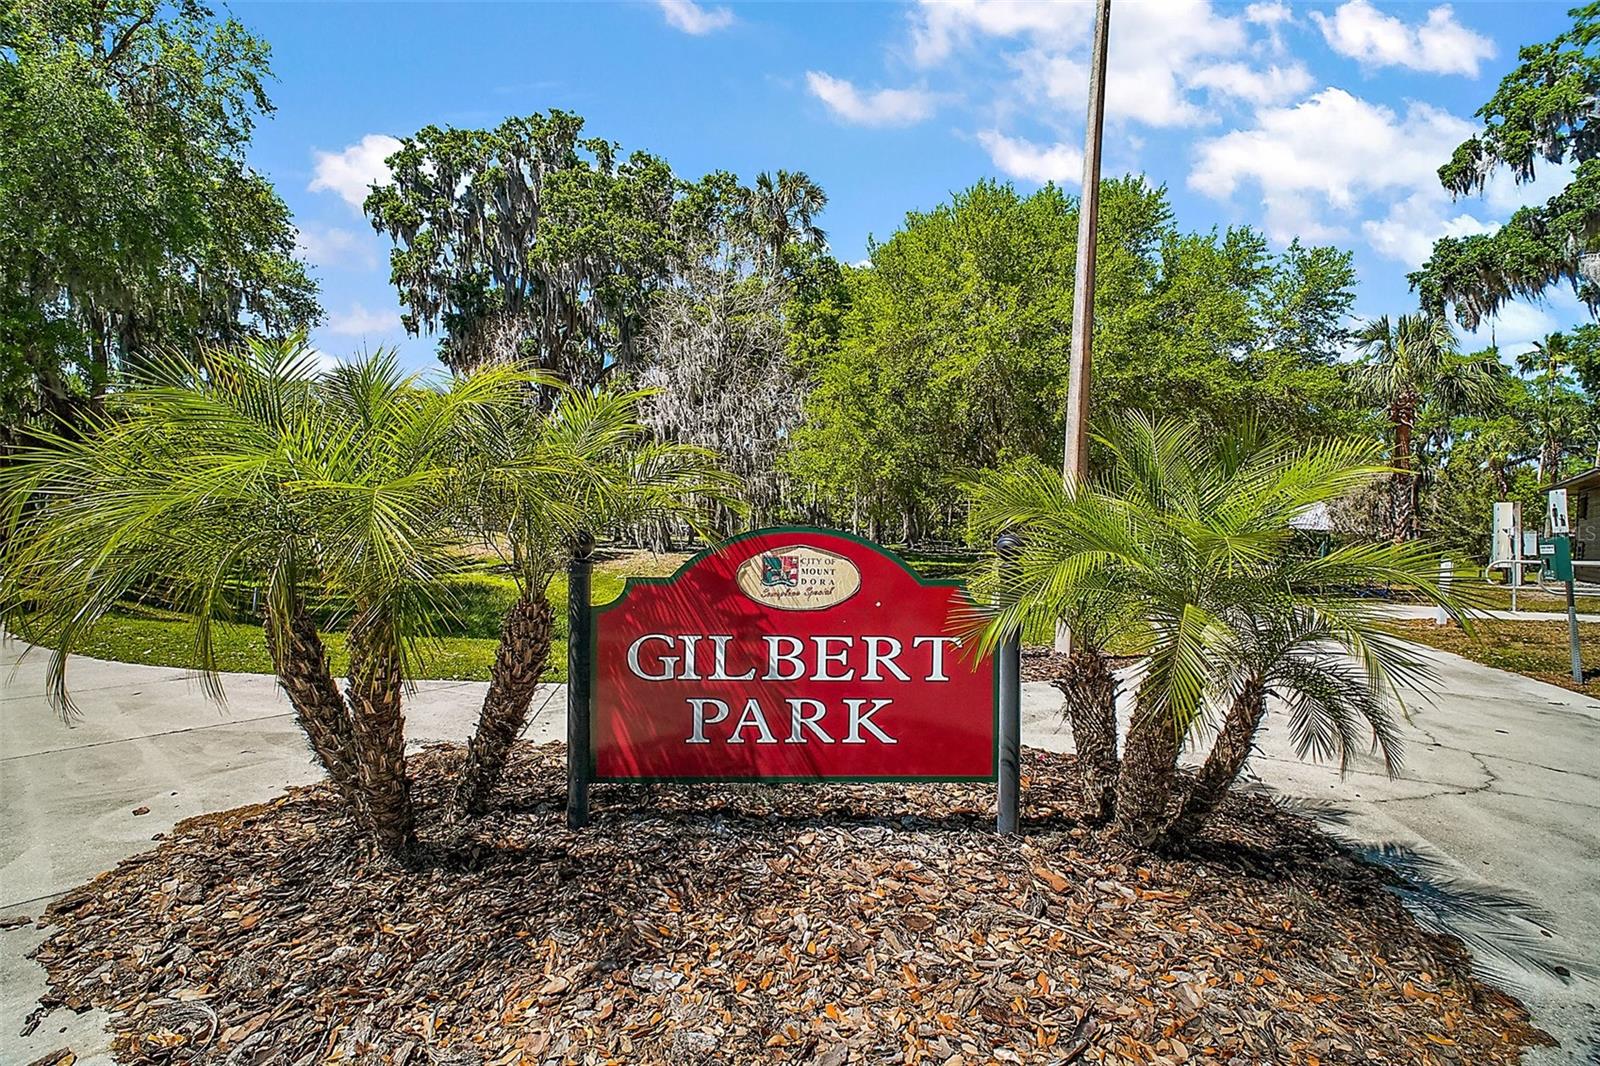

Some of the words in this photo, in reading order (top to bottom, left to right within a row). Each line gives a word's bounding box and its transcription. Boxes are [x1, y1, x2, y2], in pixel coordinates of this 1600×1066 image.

[800, 557, 822, 566] CITY
[824, 558, 836, 566] OF
[800, 567, 836, 576] MOUNT
[801, 578, 835, 586] DORA
[627, 634, 963, 681] GILBERT
[686, 698, 898, 744] PARK
